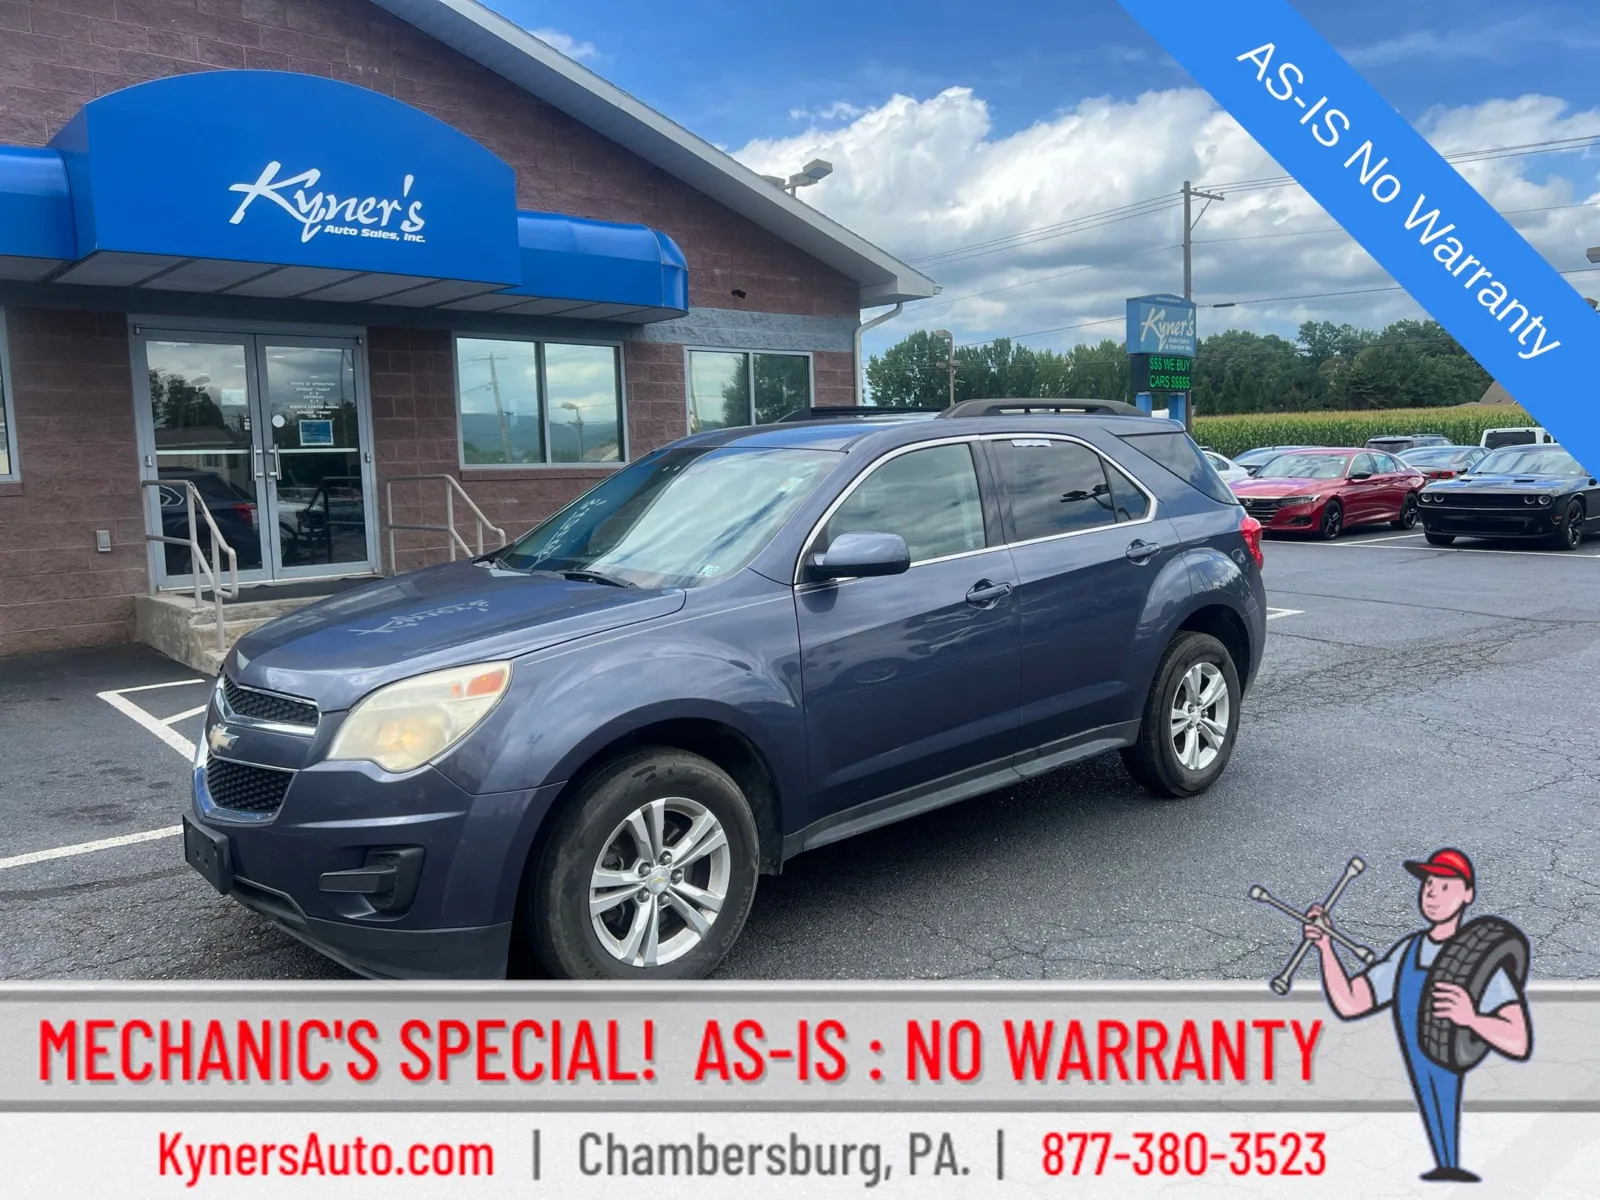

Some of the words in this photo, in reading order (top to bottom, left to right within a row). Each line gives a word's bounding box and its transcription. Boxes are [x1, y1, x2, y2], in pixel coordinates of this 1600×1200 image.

[228, 160, 426, 243] Kyner's
[323, 224, 359, 236] Auto
[360, 228, 401, 242] Sales,
[403, 232, 426, 243] Inc.
[1140, 307, 1194, 352] Kyner's
[1163, 358, 1175, 371] WE
[1176, 359, 1191, 372] BUY
[1149, 374, 1170, 388] CARS
